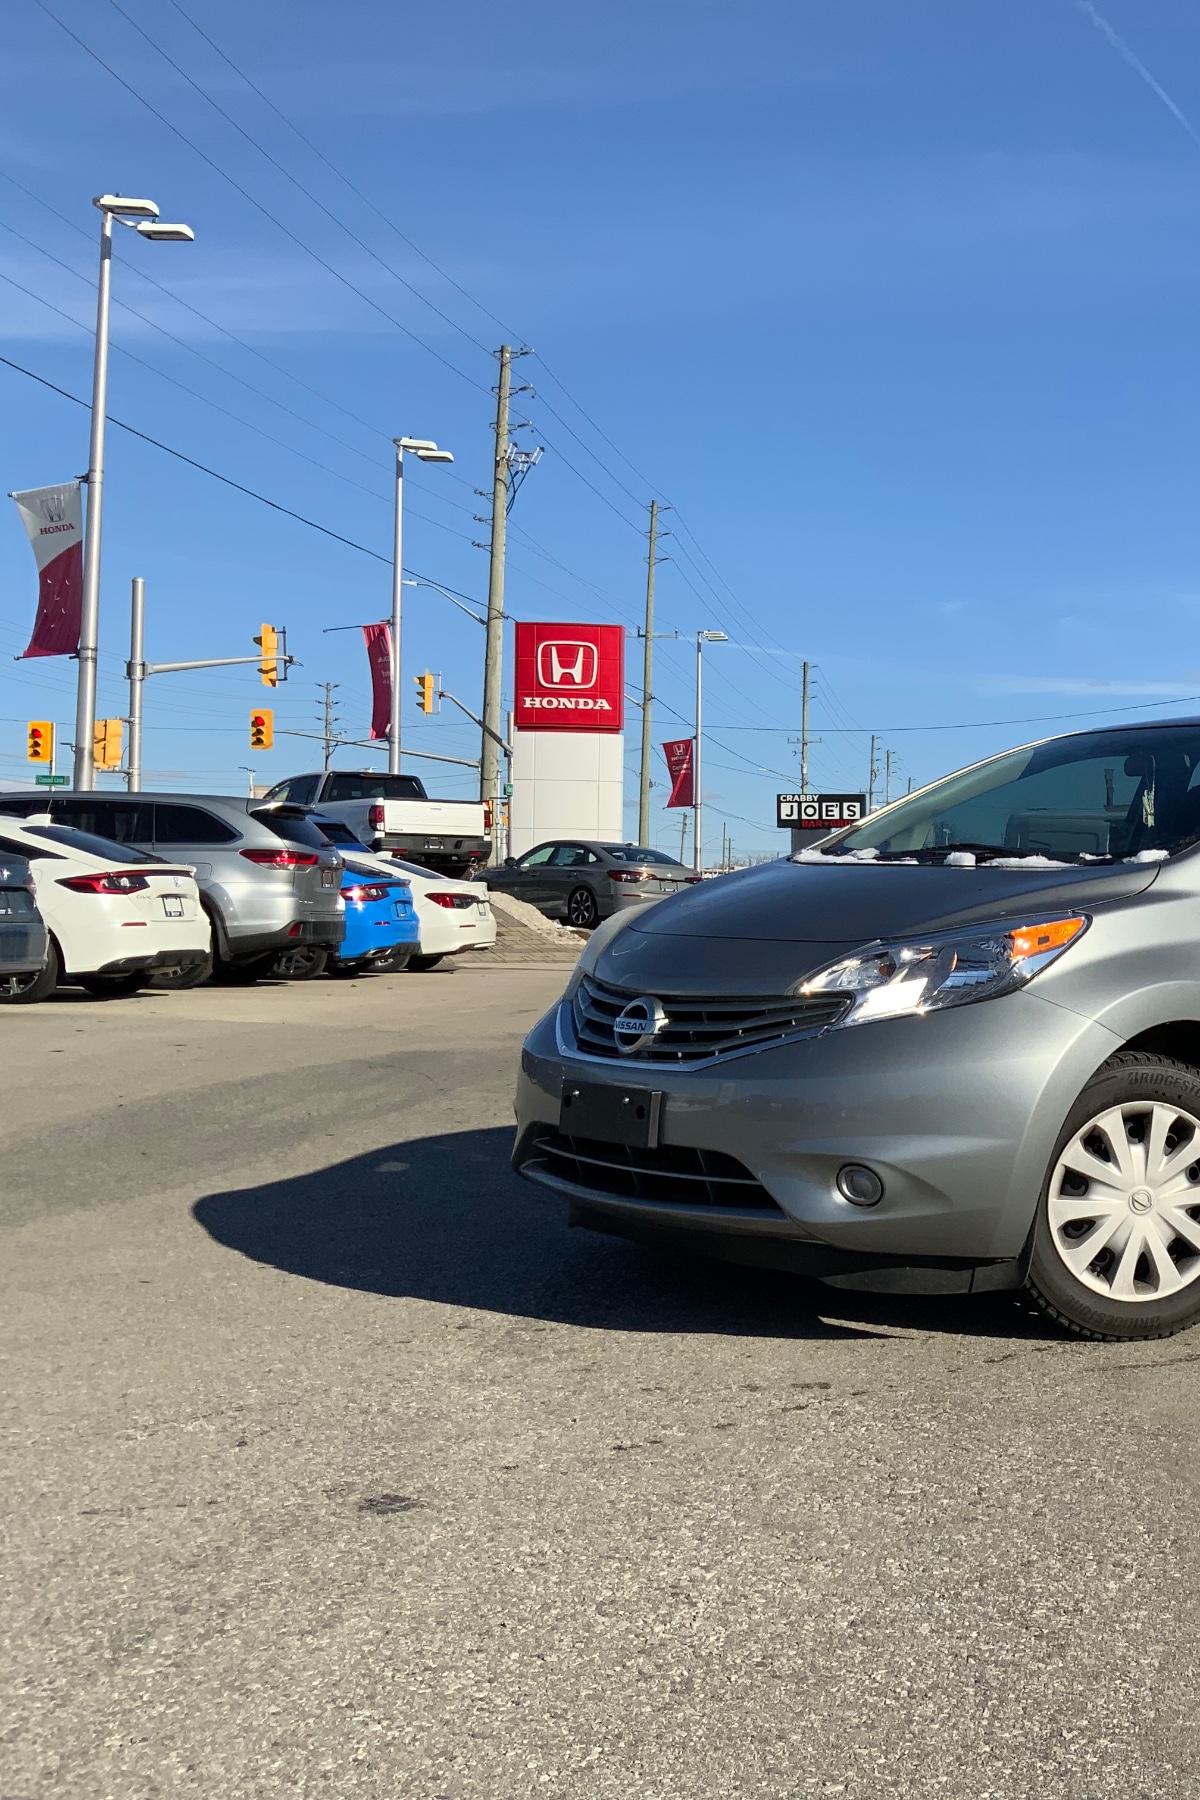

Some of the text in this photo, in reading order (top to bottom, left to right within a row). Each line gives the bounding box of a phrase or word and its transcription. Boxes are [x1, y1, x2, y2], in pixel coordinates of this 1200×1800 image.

[39, 523, 75, 535] HONDA
[523, 697, 612, 710] HONDA
[780, 794, 819, 802] CRABBY
[784, 803, 857, 818] JOE'S
[615, 1020, 647, 1031] NISSAN
